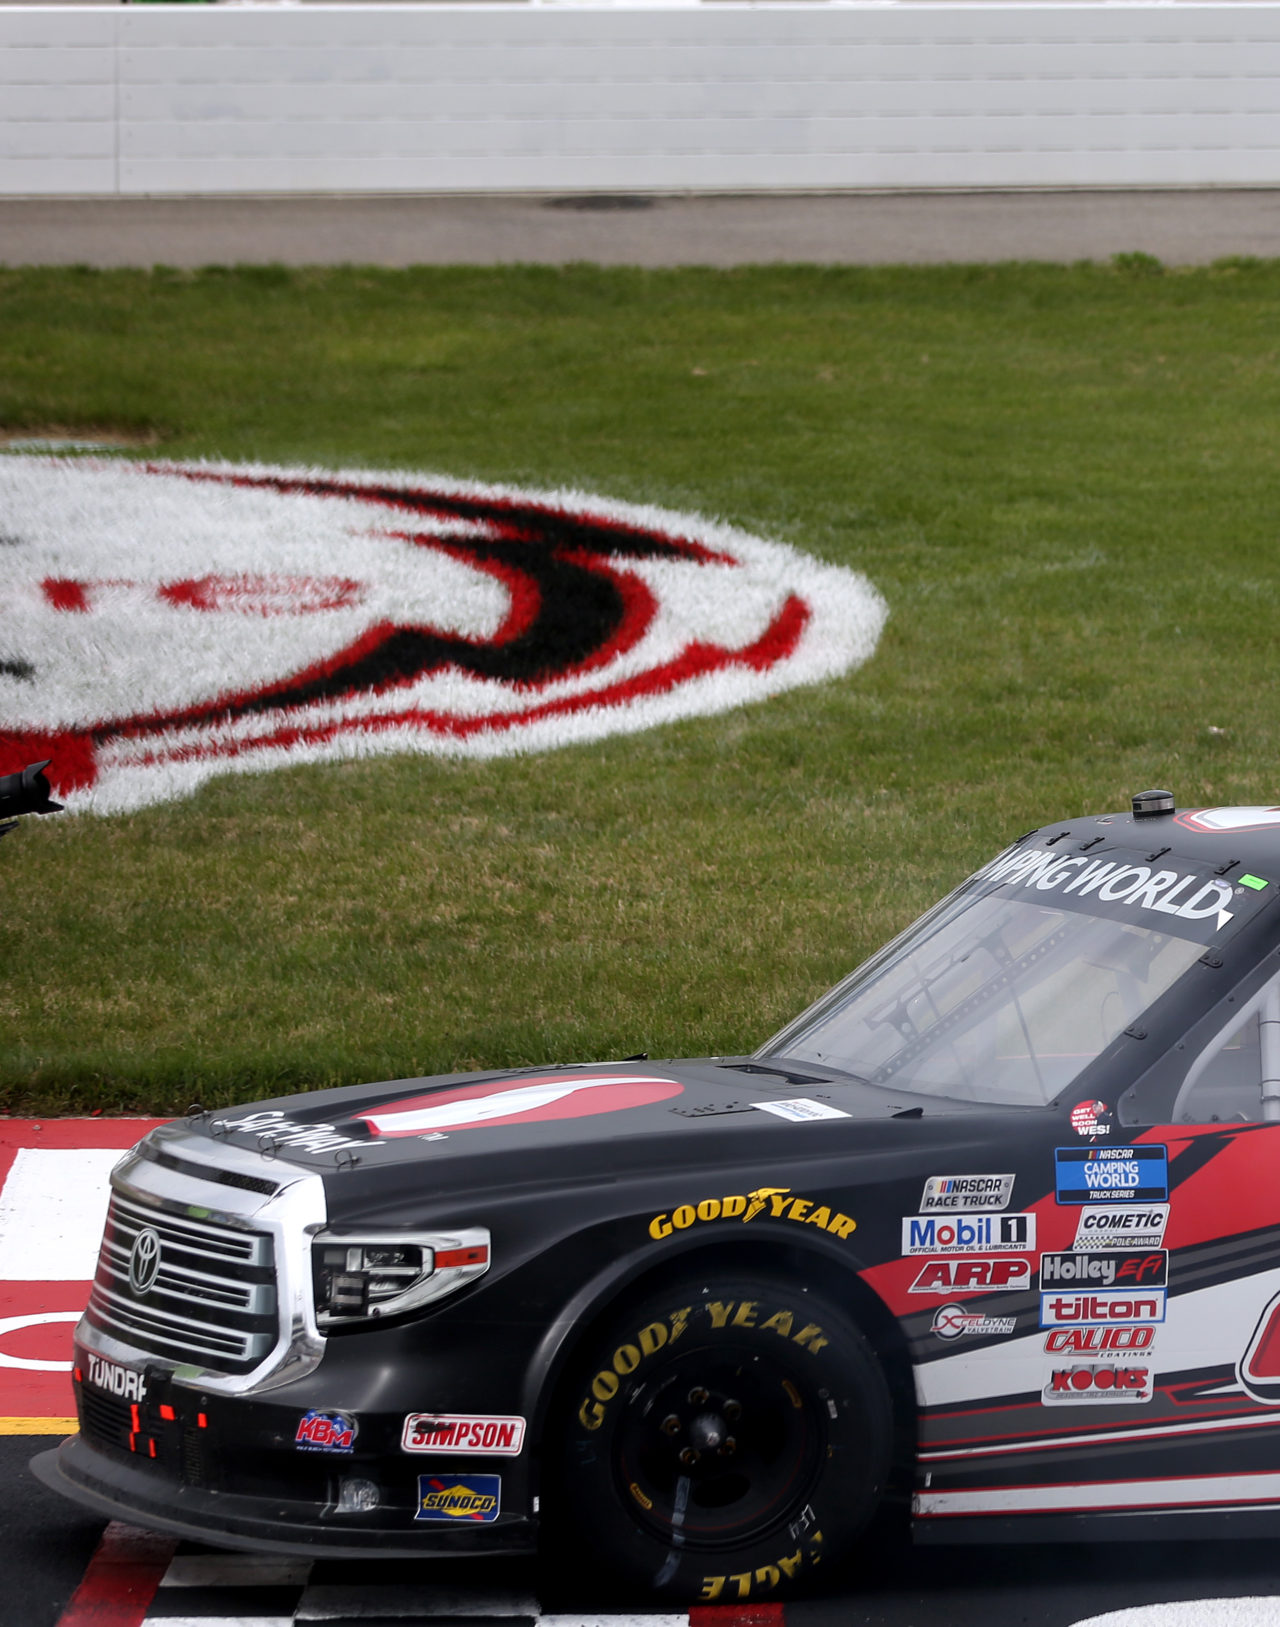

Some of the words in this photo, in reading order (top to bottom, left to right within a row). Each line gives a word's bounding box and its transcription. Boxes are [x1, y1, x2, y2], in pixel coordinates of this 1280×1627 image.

[1064, 860, 1233, 919] WORLD
[1071, 1113, 1096, 1121] WELL
[1073, 1107, 1091, 1115] GET
[1072, 1119, 1098, 1127] SOON
[1077, 1124, 1110, 1136] WES!
[1099, 1149, 1134, 1160] NASCAR
[1084, 1161, 1139, 1174] CAMPING
[951, 1179, 1002, 1194] NASCAR
[1085, 1173, 1140, 1188] WORLD
[926, 1196, 958, 1207] RACE
[962, 1195, 1003, 1206] TRUCK
[1089, 1190, 1111, 1200] TRUCK
[1111, 1189, 1135, 1199] SERIES
[1083, 1212, 1163, 1229] COMETIC
[909, 1217, 992, 1247] Mobil
[1111, 1238, 1131, 1247] POLE
[1132, 1237, 1160, 1246] AWARD
[913, 1261, 1029, 1288] ARP
[1043, 1255, 1116, 1286] Holley
[1049, 1297, 1157, 1320] tilton
[1044, 1327, 1156, 1353] CALICO
[1051, 1367, 1148, 1391] KOOKS
[296, 1417, 354, 1446] KBM
[412, 1421, 516, 1448] SIMPSON
[423, 1491, 497, 1511] SUNOCO
